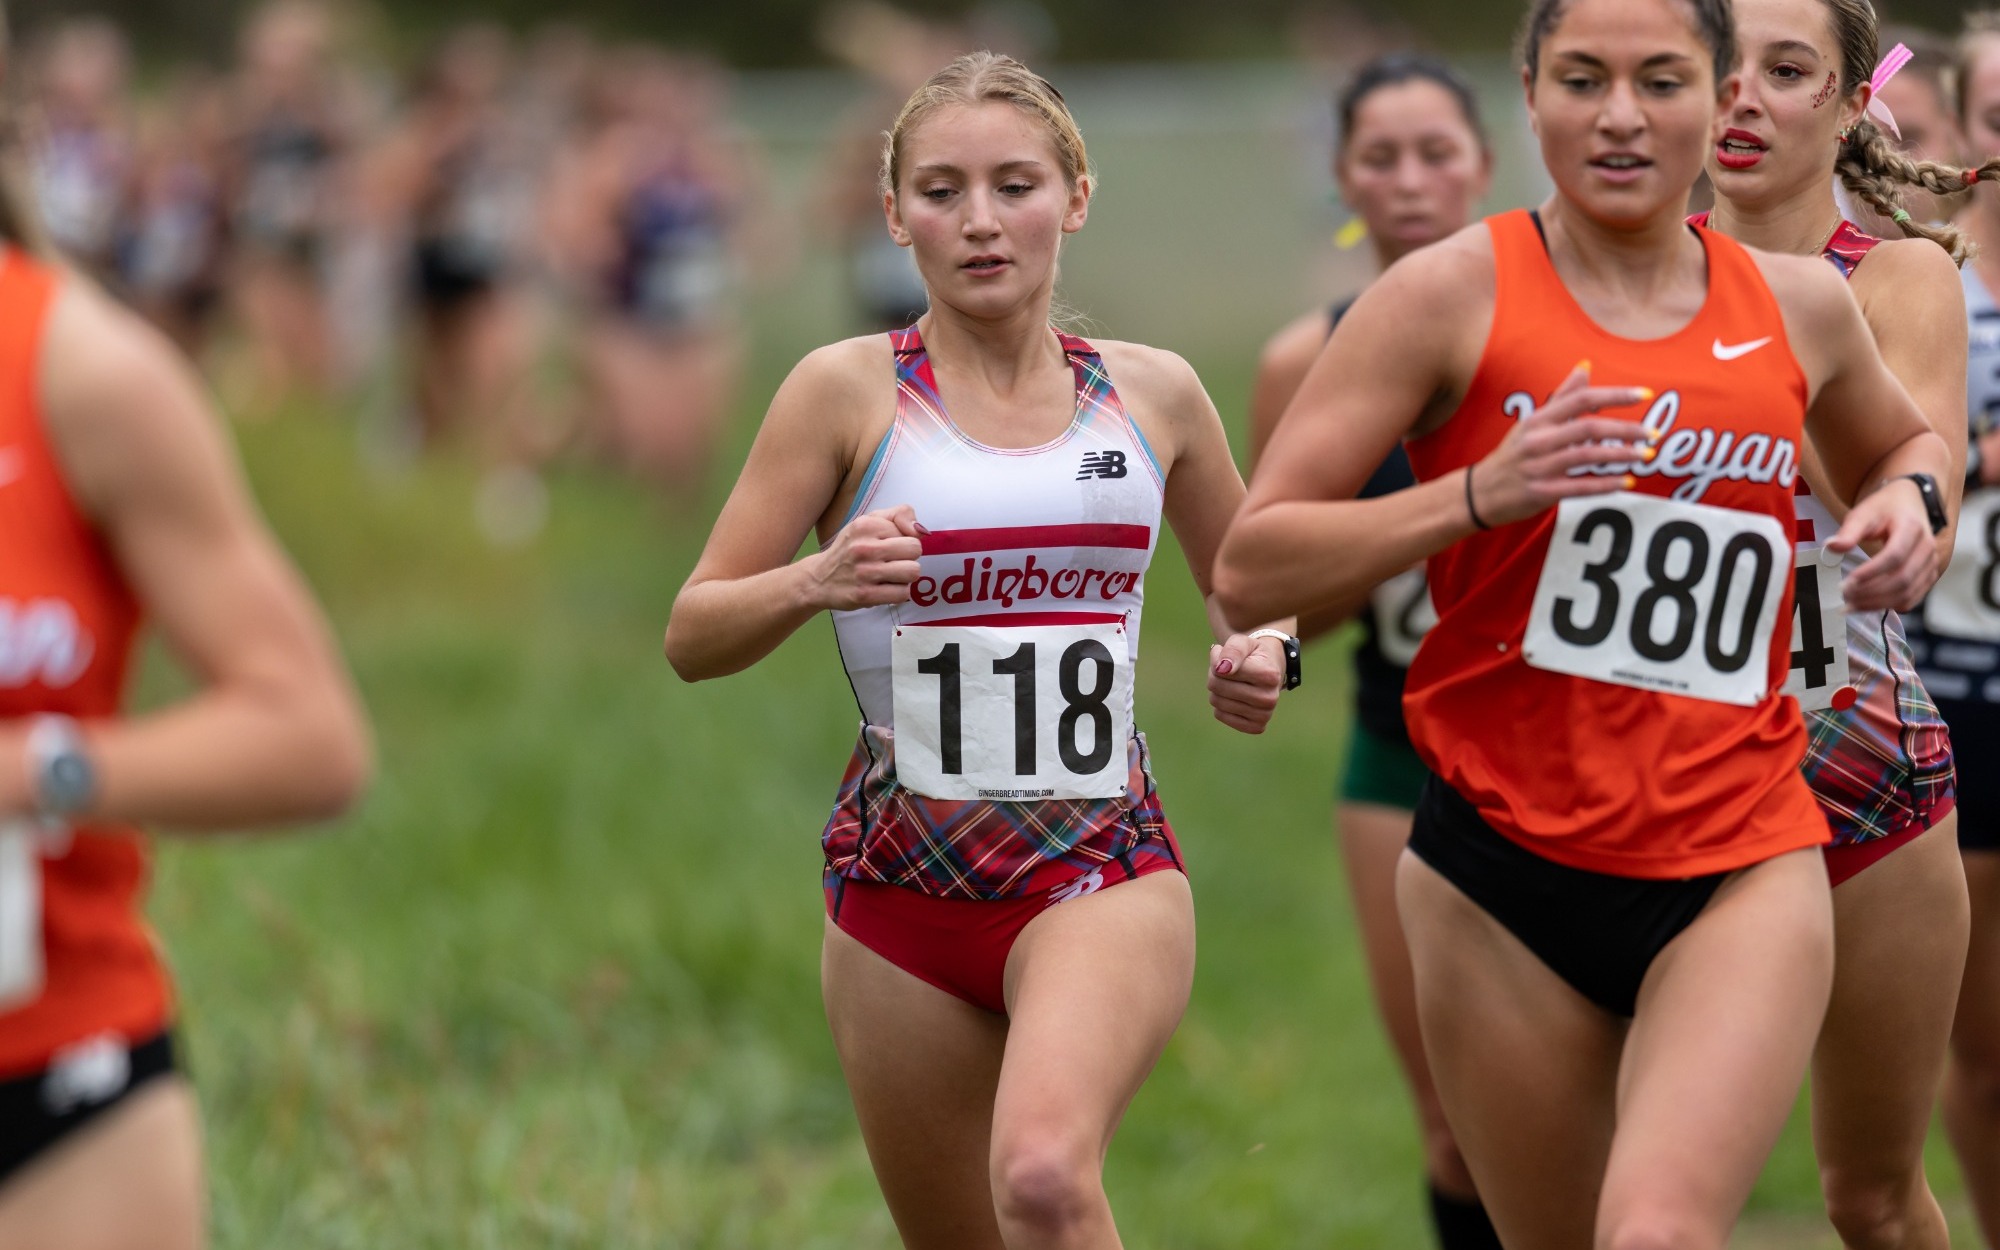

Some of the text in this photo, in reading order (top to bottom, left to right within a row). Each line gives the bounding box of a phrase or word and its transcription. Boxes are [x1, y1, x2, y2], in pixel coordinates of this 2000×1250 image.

[1552, 508, 1773, 674] 380
[917, 638, 1115, 776] 118
[978, 789, 1055, 798] GINGERBREADTIMING.COM
